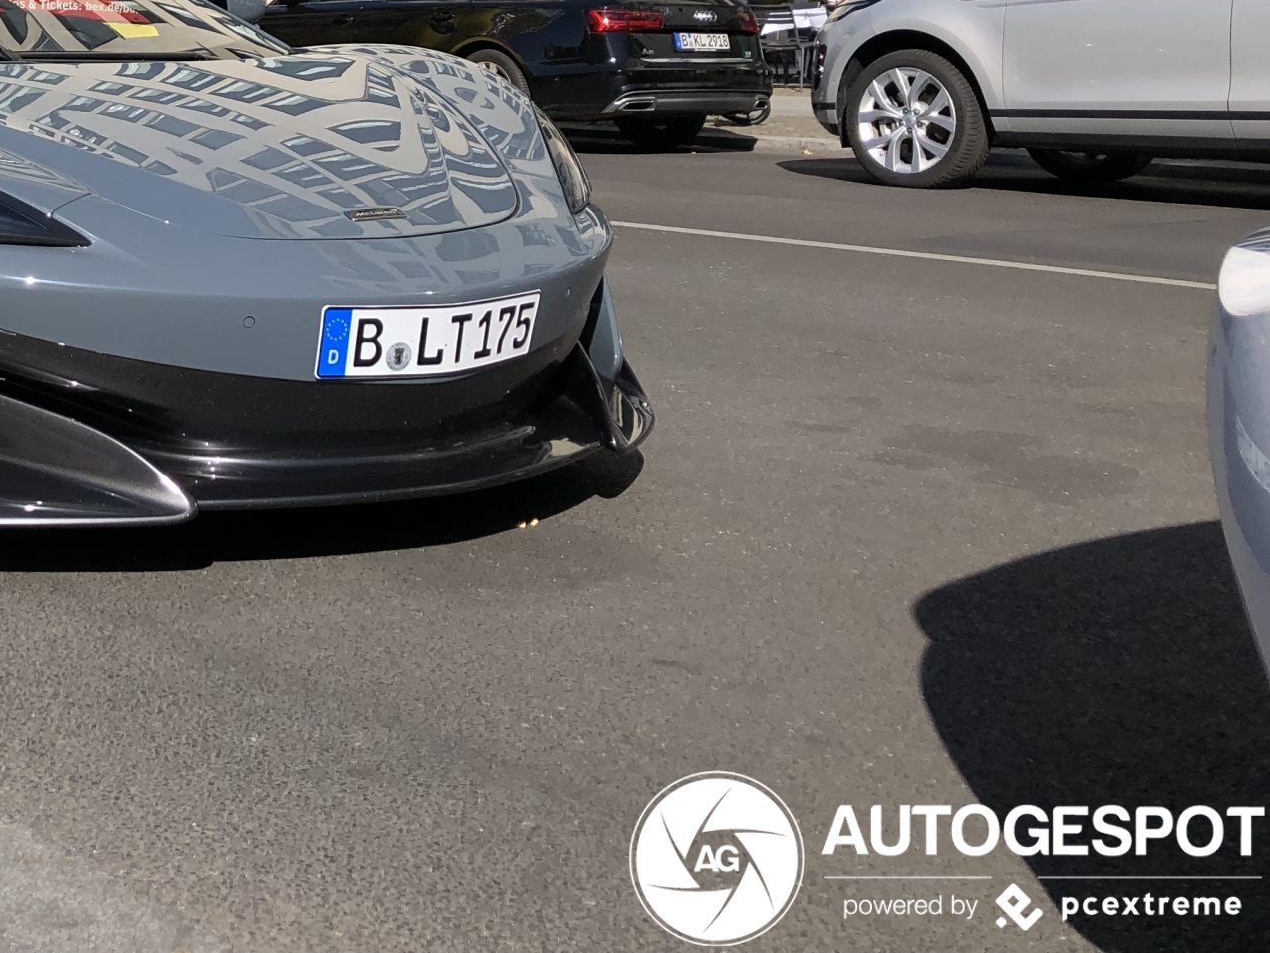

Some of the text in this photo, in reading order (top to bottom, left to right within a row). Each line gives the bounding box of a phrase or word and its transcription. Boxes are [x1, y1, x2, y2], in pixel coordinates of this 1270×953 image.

[28, 0, 36, 10] &
[39, 0, 82, 12] Tickets:
[85, 0, 138, 14] bex.de/bu
[680, 34, 689, 47] B
[707, 34, 729, 47] 2918
[327, 349, 339, 364] D
[353, 318, 383, 367] B
